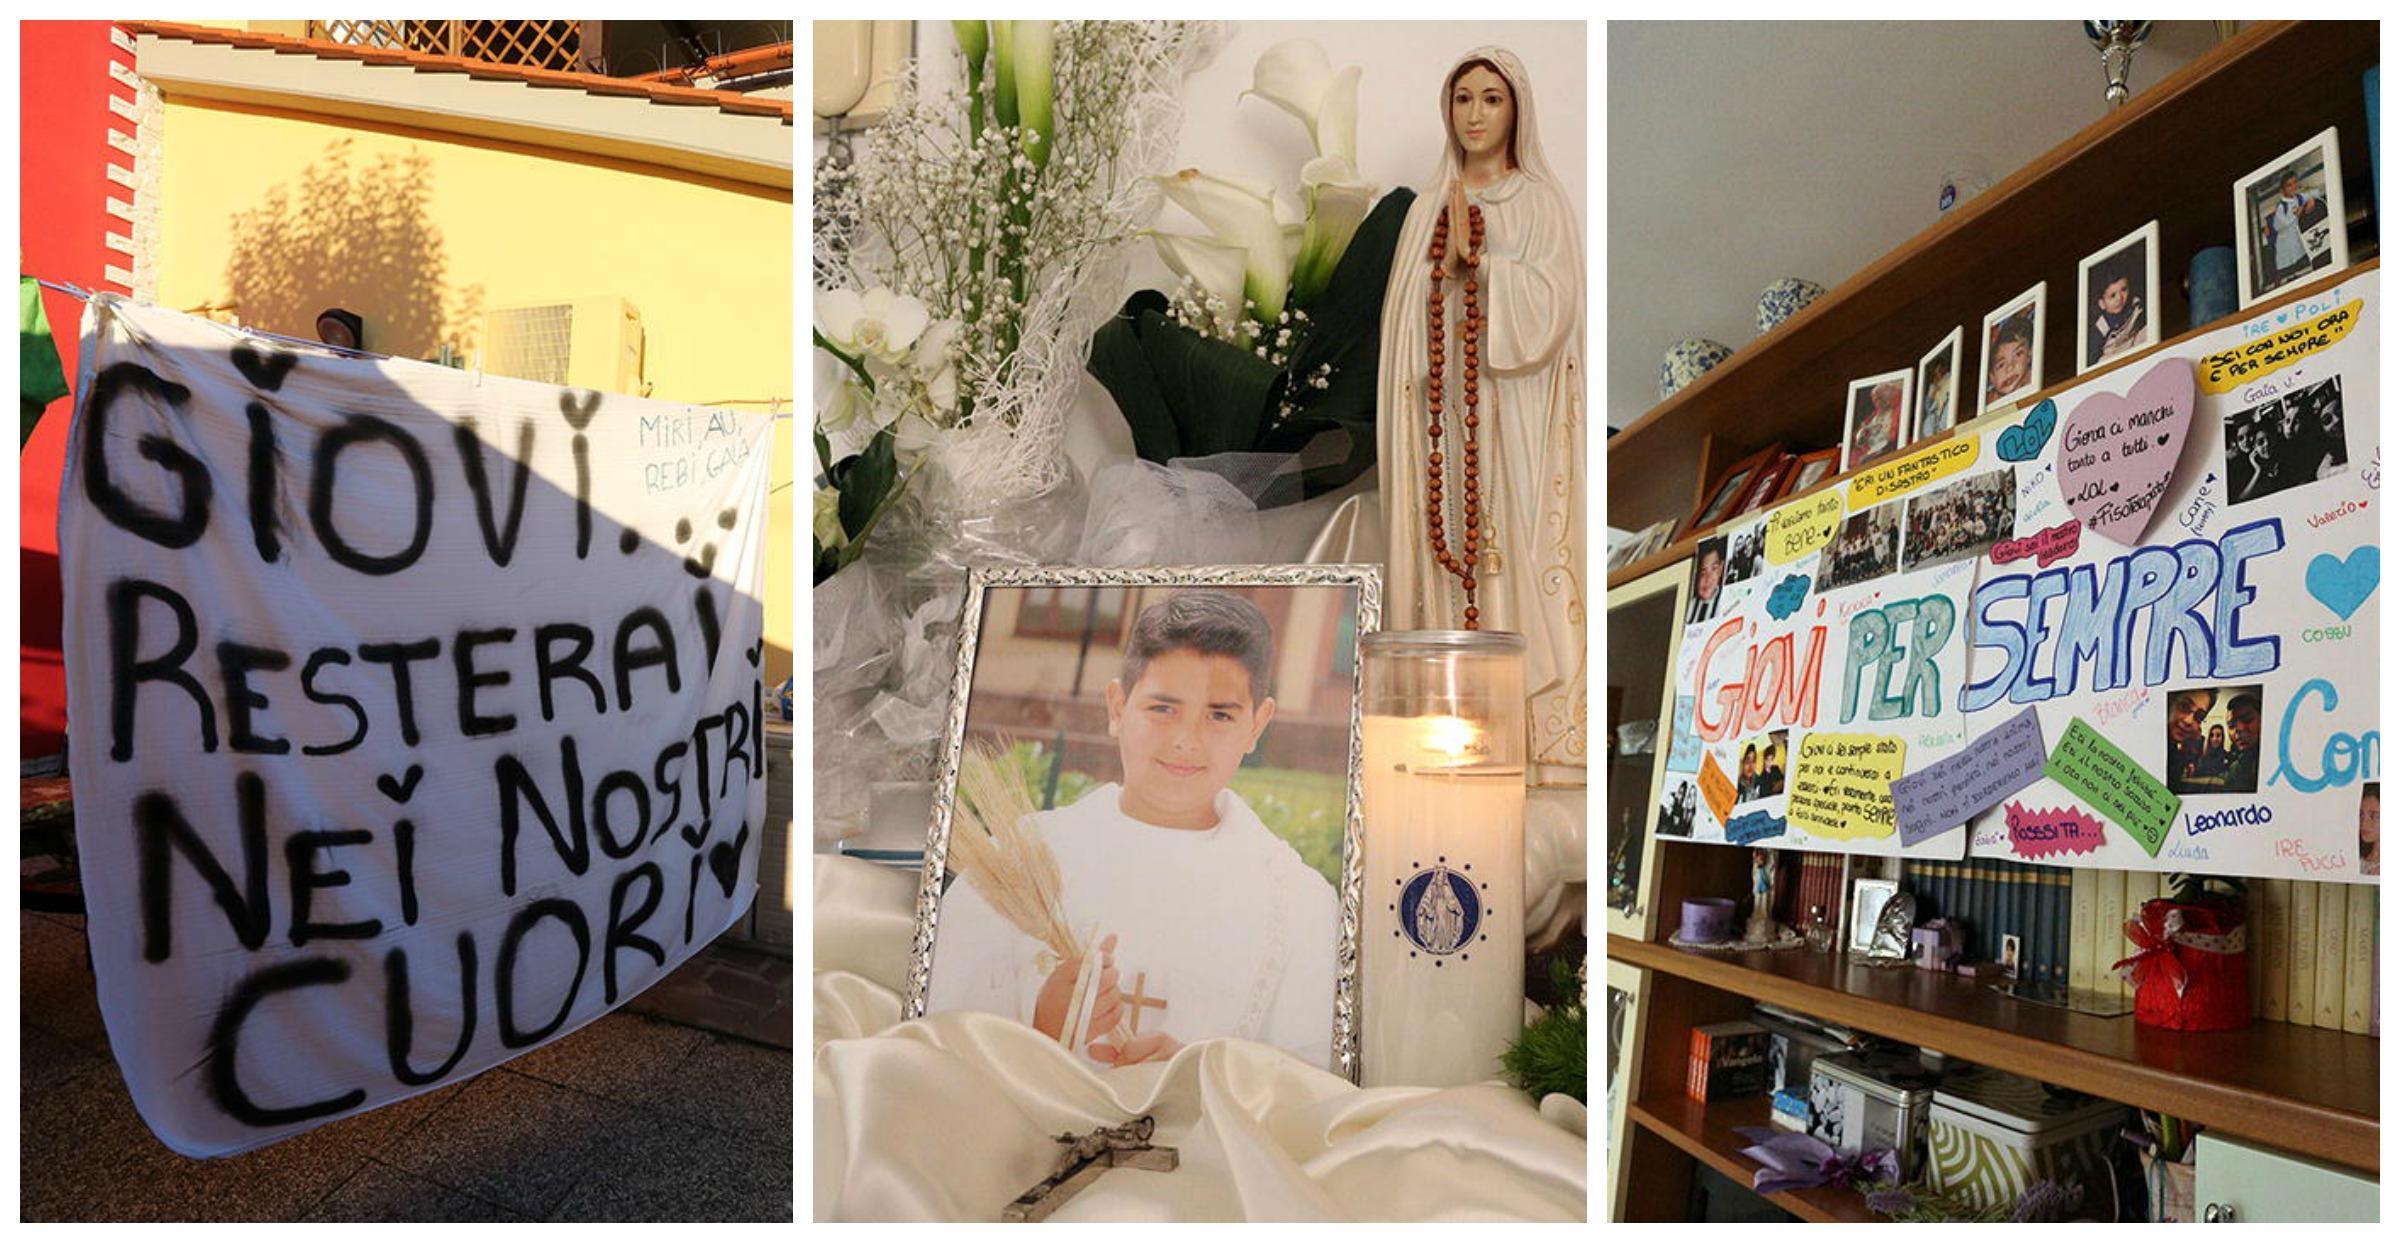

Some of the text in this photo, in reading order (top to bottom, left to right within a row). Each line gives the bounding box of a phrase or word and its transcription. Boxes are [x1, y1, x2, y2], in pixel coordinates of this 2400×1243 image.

[2246, 338, 2274, 356] CON
[2278, 326, 2310, 346] NOI
[2318, 310, 2349, 332] ORA
[2229, 361, 2259, 378] PER
[2068, 454, 2096, 473] tanto
[2101, 450, 2111, 463] a
[1878, 469, 1895, 482] UN
[2306, 502, 2356, 529] Valerio
[1840, 593, 1956, 724] PER
[1957, 517, 2285, 712] SEMPRE
[2185, 804, 2272, 836] Leonardo
[2275, 839, 2304, 858] IRE
